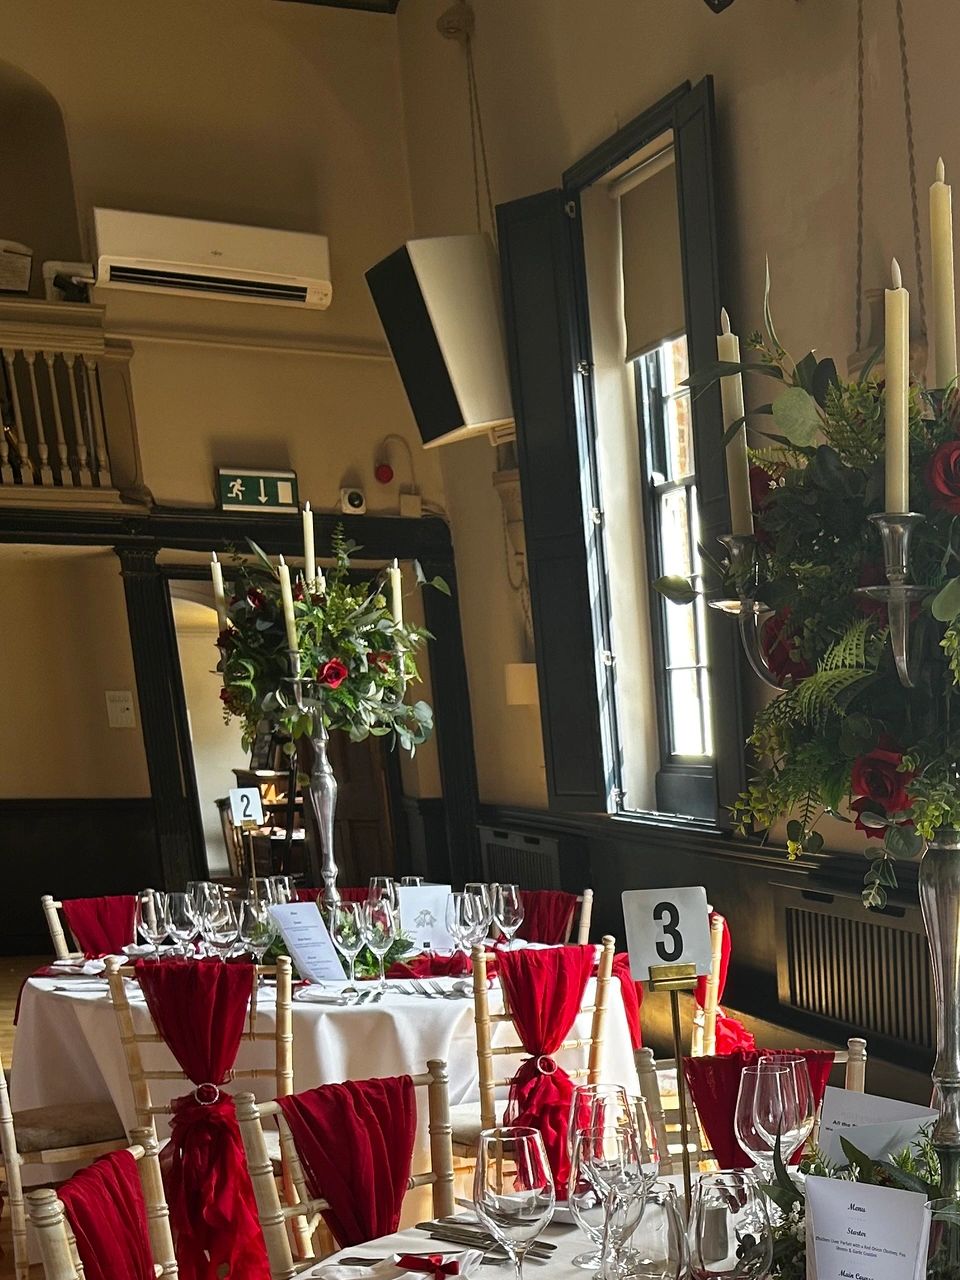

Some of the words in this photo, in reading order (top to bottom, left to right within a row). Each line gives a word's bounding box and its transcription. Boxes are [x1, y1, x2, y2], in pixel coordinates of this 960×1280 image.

[241, 794, 252, 817] 2
[653, 902, 683, 962] 3
[848, 1203, 866, 1212] Menu
[846, 1227, 866, 1237] Starter
[838, 1270, 854, 1279] Main
